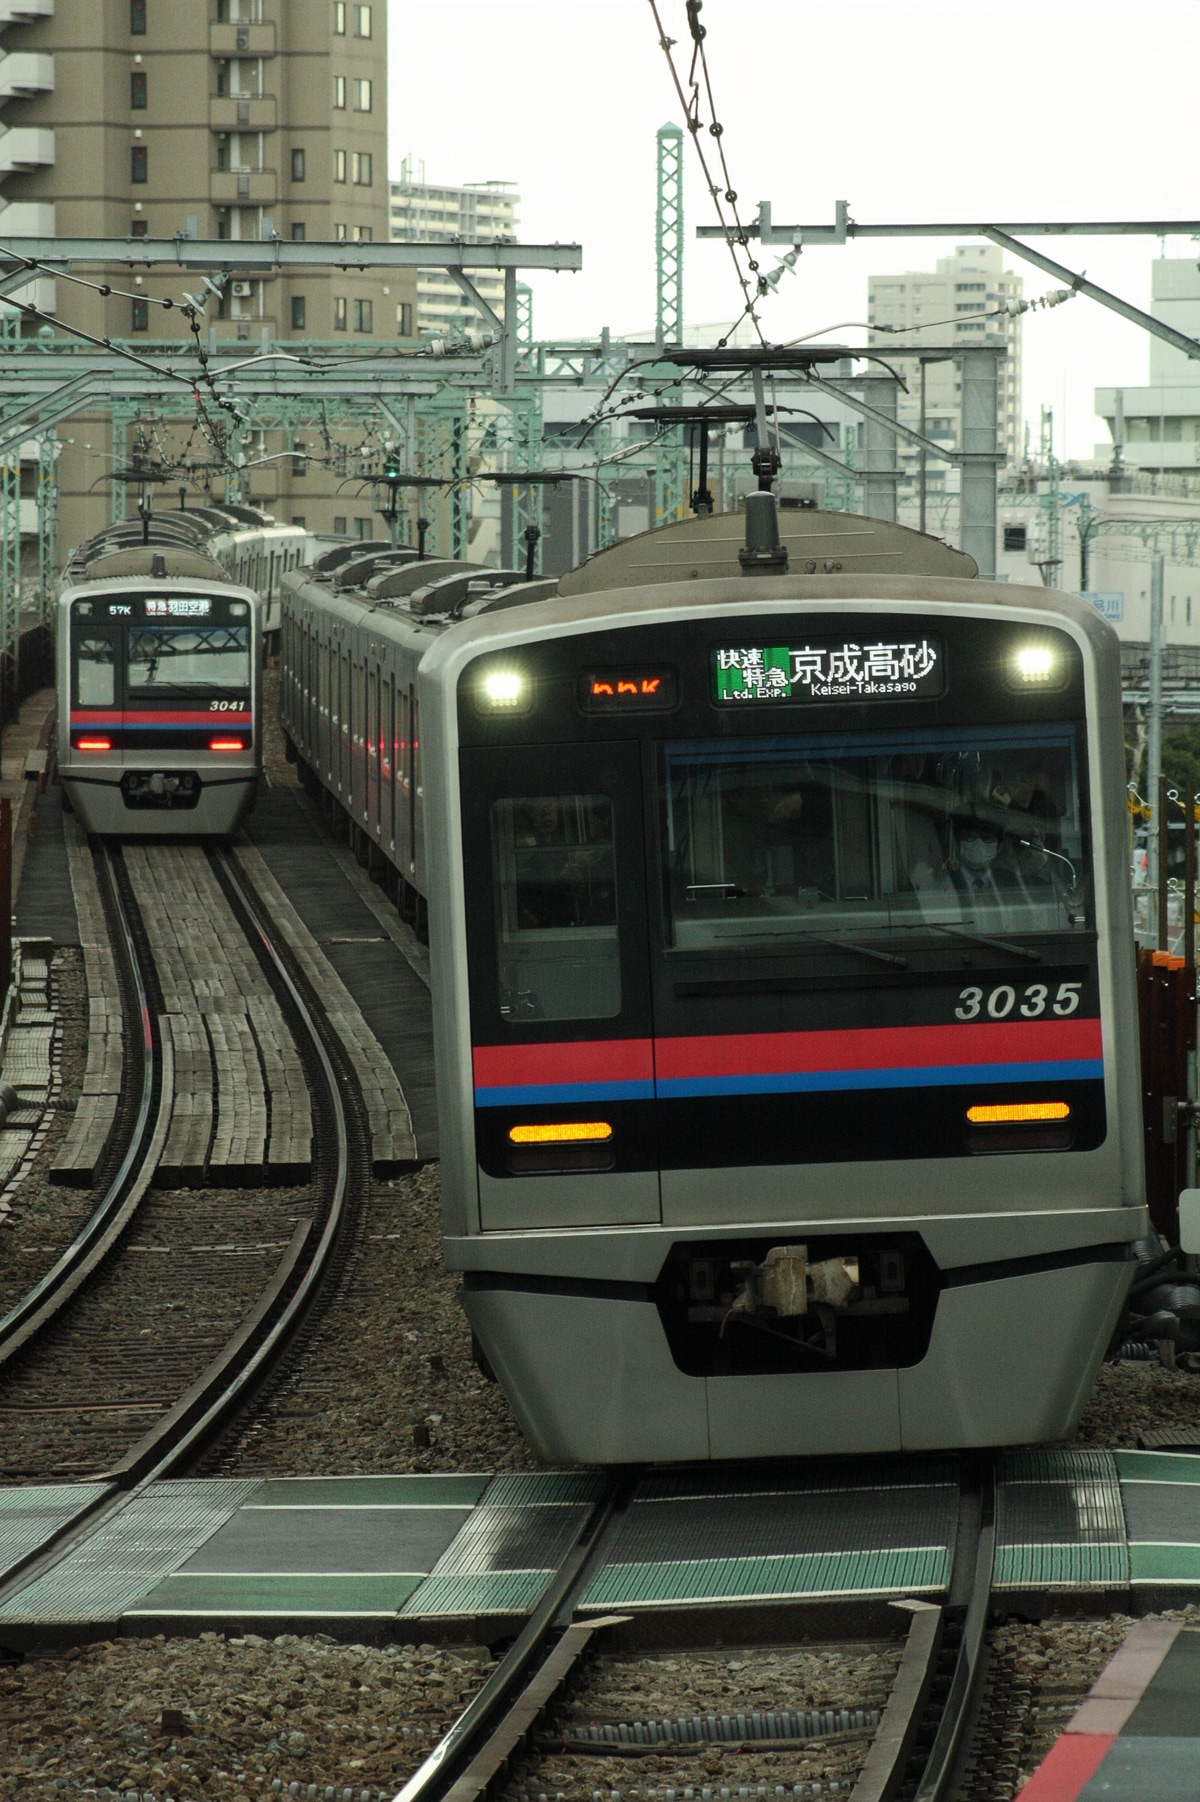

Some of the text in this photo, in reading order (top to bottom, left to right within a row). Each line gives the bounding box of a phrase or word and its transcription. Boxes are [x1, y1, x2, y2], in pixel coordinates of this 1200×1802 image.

[109, 605, 131, 615] 57K
[168, 600, 210, 613] 羽田空港
[717, 648, 764, 669] 快速
[788, 640, 937, 684] 京成高砂
[743, 667, 789, 688] 特急
[723, 688, 753, 700] Ltd.
[811, 681, 917, 696] Keisei-Takasago
[209, 701, 245, 711] 3041
[955, 982, 1082, 1020] 3035
